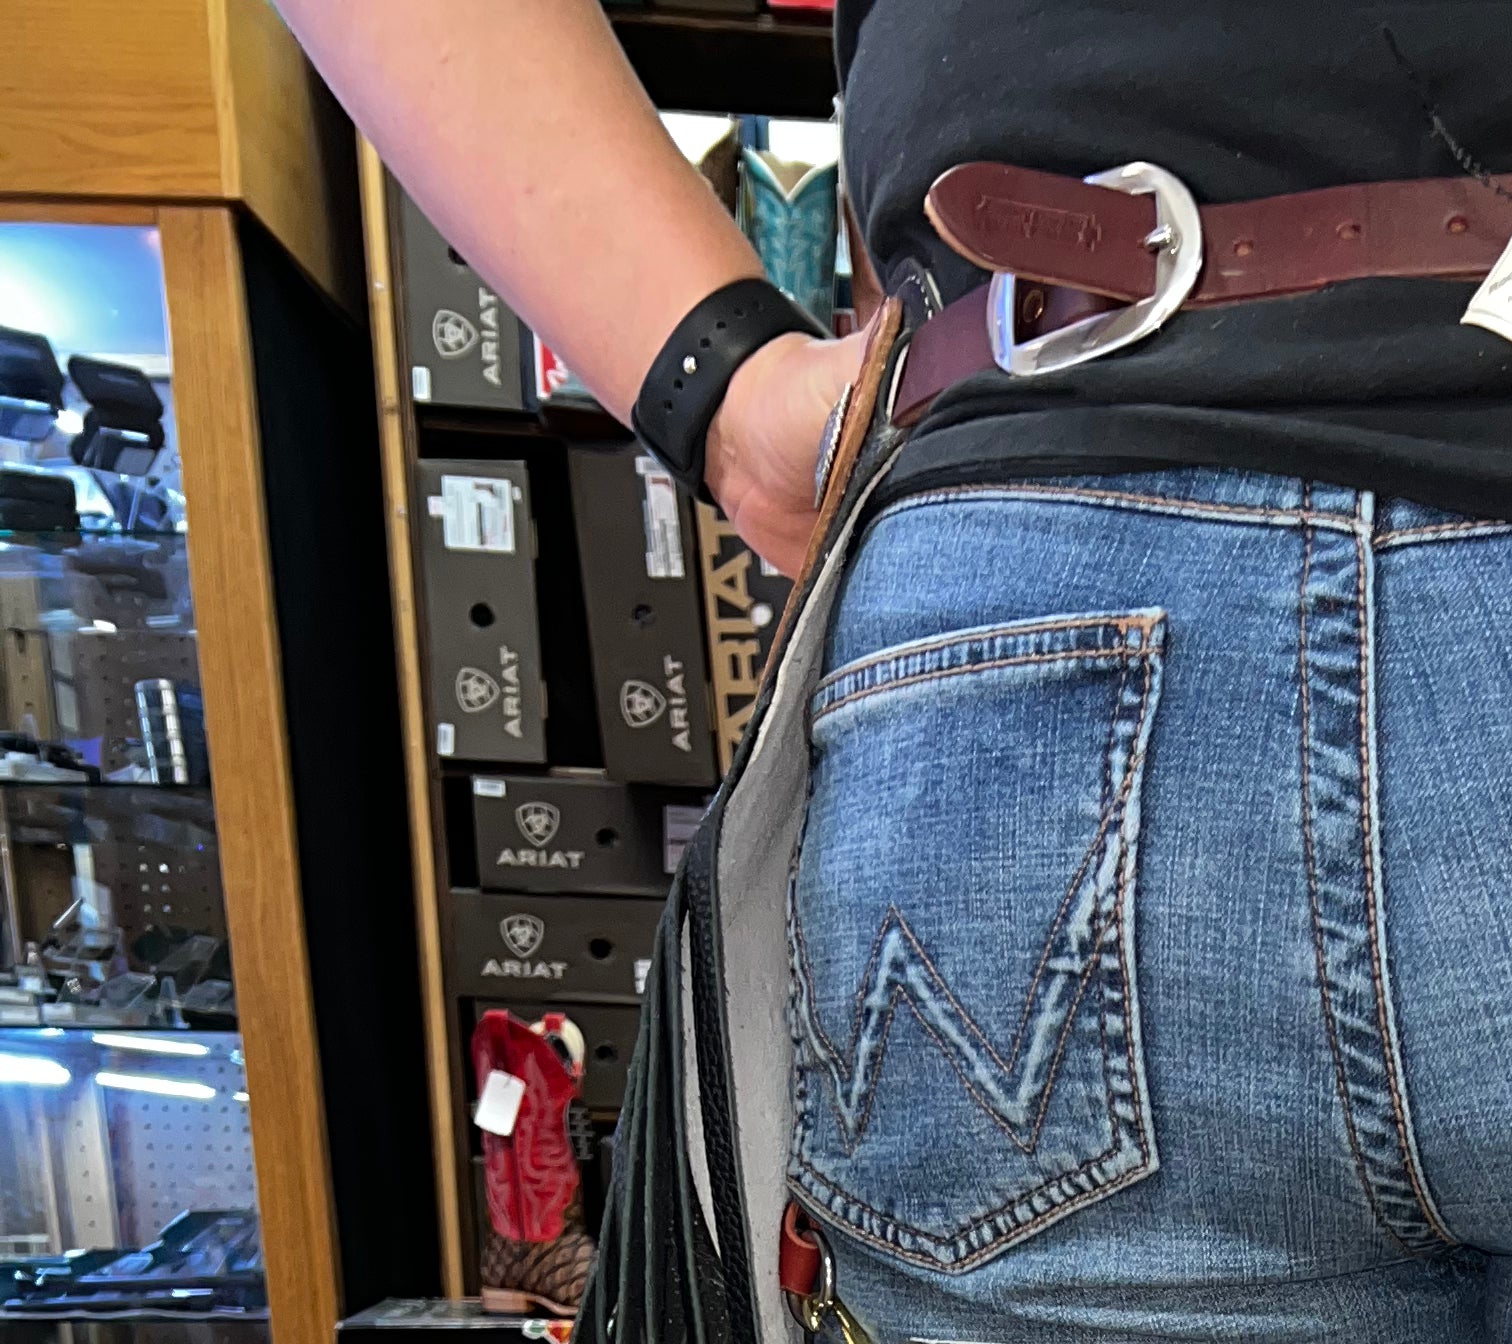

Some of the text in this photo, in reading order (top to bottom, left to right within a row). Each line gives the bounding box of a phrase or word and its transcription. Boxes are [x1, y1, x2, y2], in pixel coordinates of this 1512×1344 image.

[478, 286, 502, 386] ARIAT
[499, 645, 523, 738] ARIAT
[663, 654, 692, 753] ARIAT
[496, 848, 586, 870] ARIAT
[480, 958, 568, 980] ARIAT
